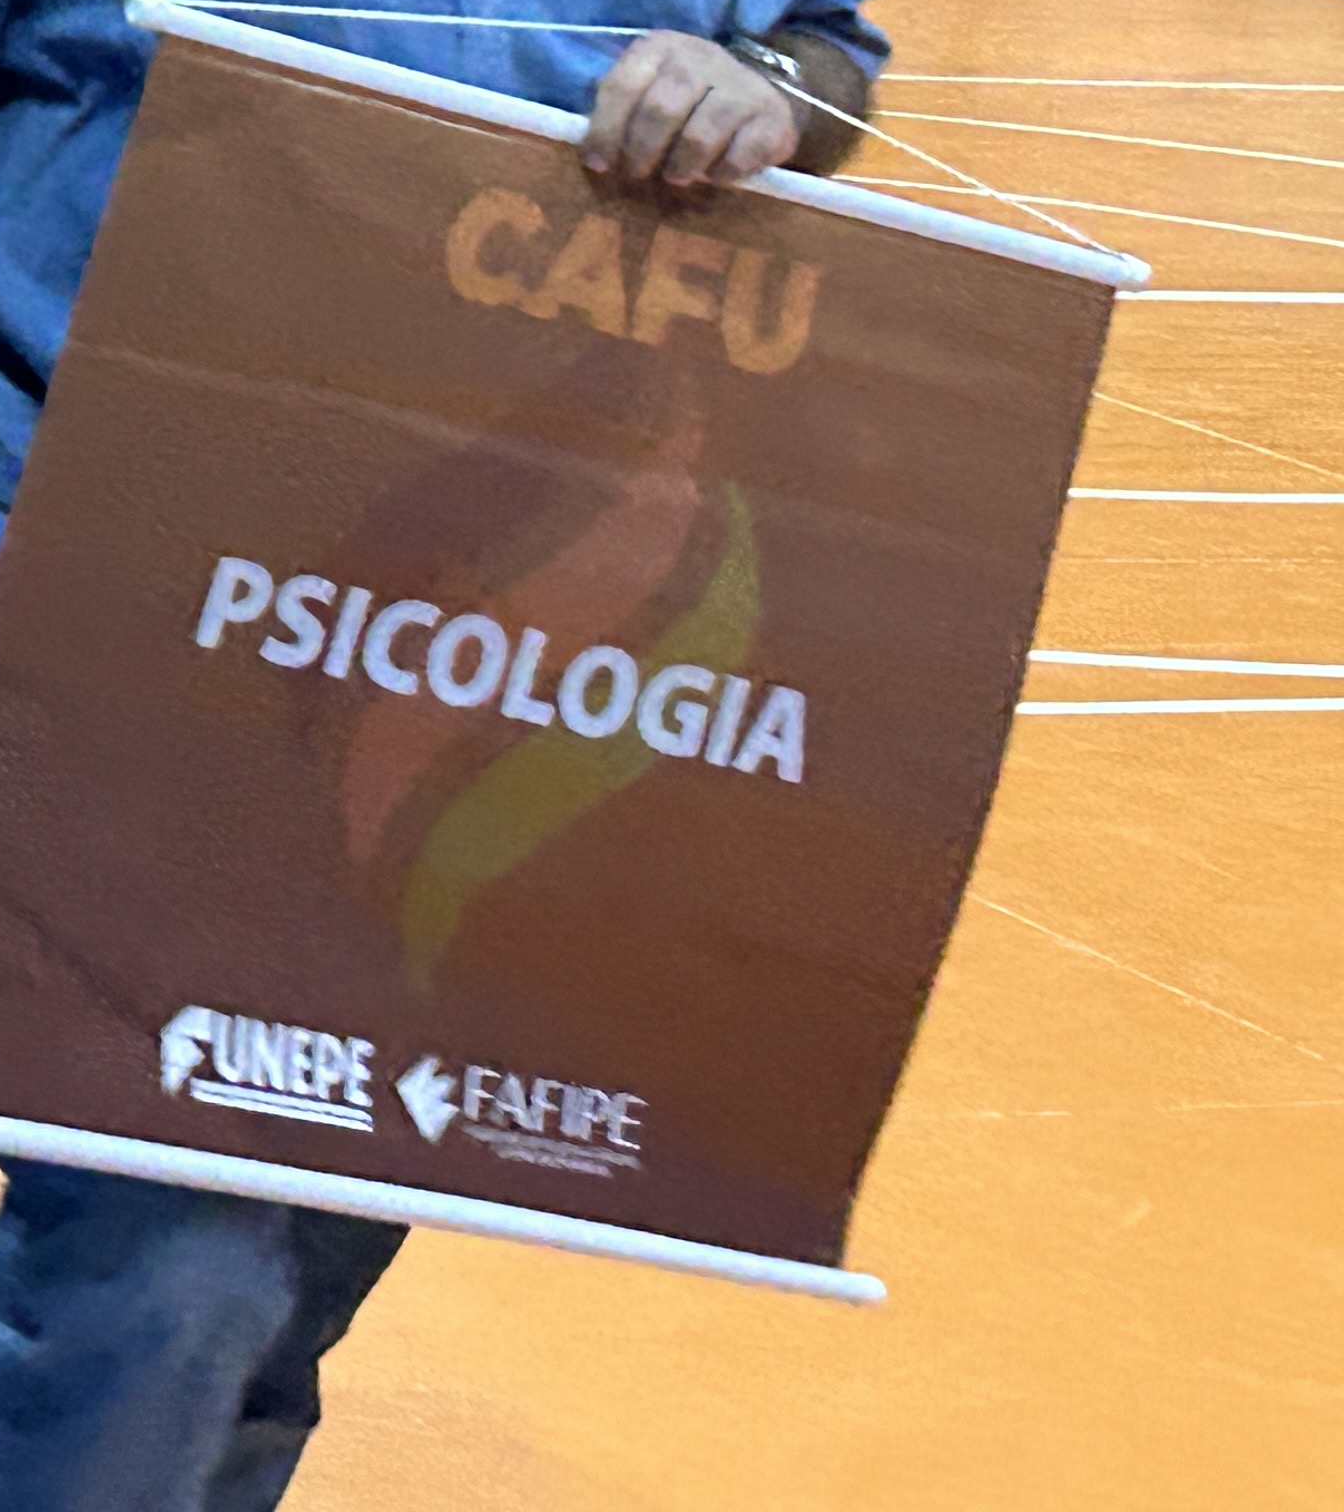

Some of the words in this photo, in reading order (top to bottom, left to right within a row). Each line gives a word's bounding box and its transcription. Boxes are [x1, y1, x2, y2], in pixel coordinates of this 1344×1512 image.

[446, 190, 821, 375] CAFU
[195, 555, 807, 784] PSICOLOGIA
[160, 1004, 376, 1108] FUNEPE
[462, 1064, 650, 1151] FAFIPE
